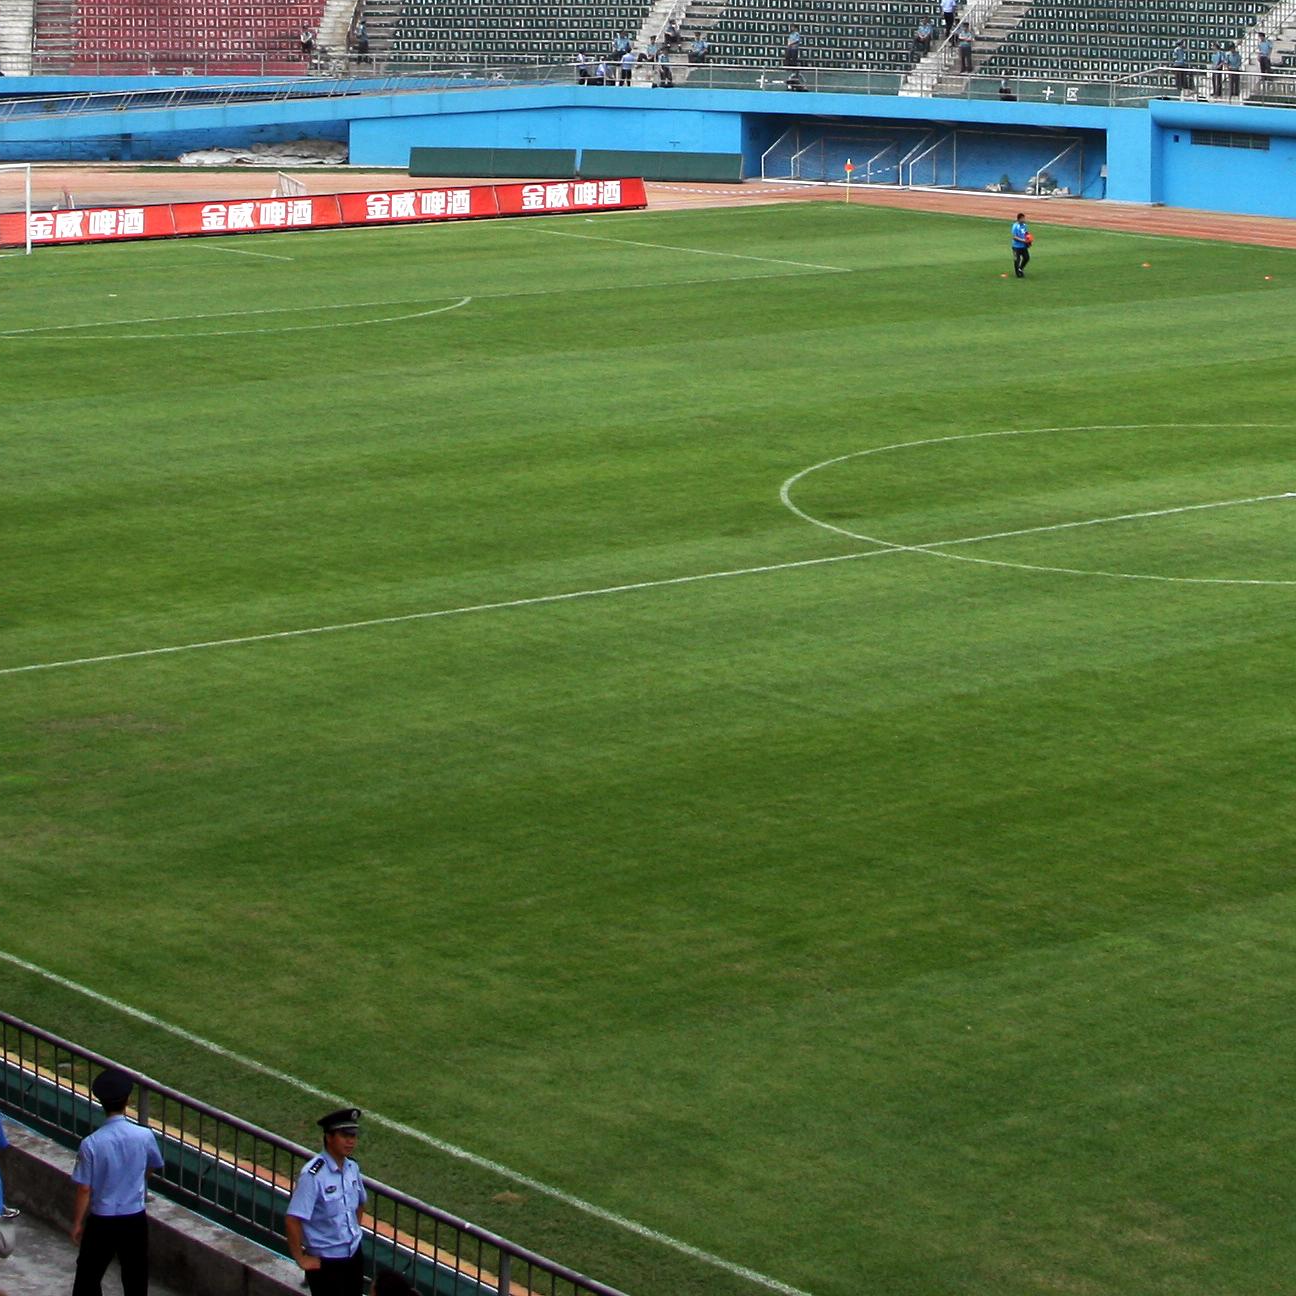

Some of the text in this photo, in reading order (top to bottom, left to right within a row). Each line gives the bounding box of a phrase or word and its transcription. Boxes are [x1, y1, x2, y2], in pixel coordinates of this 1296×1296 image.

[1042, 84, 1080, 102] 十区
[365, 190, 470, 219] 金威啤酒
[520, 182, 621, 210] 金威啤酒
[30, 209, 144, 240] 金威啤酒
[201, 200, 312, 231] 金威啤酒
